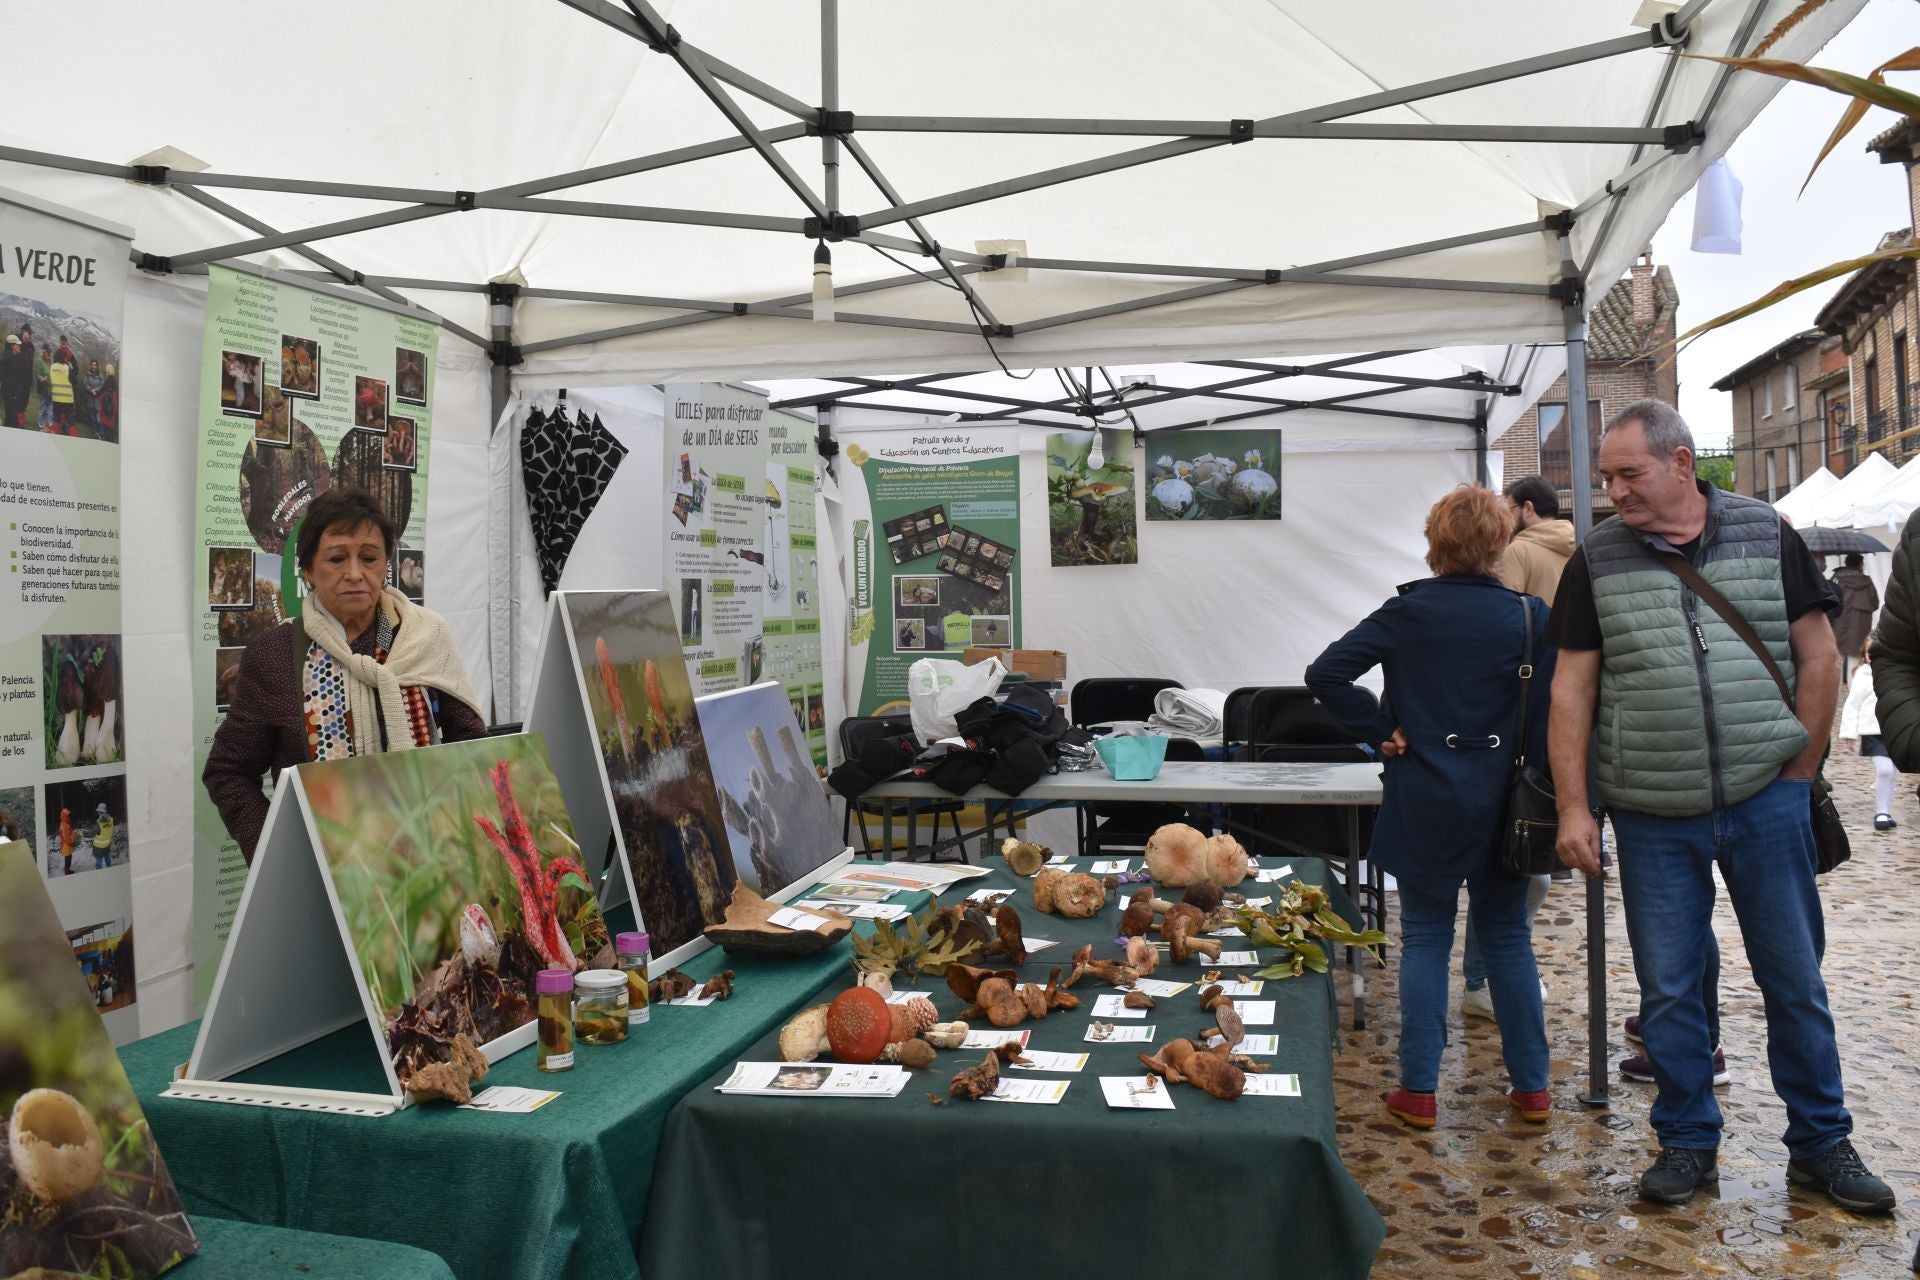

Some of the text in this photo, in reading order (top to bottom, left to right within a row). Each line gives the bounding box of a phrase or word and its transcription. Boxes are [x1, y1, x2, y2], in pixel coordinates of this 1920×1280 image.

[16, 246, 96, 286] VERDE
[676, 398, 763, 423] ÚTILES para disfrutar
[208, 430, 236, 439] Clitocybe
[683, 426, 758, 446] de un DÍA de SETAS
[943, 435, 963, 444] Verde
[880, 448, 918, 456] Educación
[932, 447, 960, 456] Centros
[963, 445, 1004, 454] Educativos
[879, 466, 908, 474] Diputación
[10, 480, 24, 492] que
[18, 494, 27, 504] de
[30, 498, 75, 508] ecosistemas
[77, 502, 110, 512] presentes
[22, 523, 54, 534] Conocen
[56, 526, 62, 535] la
[65, 526, 107, 538] importancia
[21, 537, 73, 549] biodiversidad.
[22, 551, 44, 561] Saben
[69, 553, 100, 564] disfrutar
[102, 555, 109, 564] de
[22, 565, 45, 575] Saben
[62, 566, 82, 576] hacer
[85, 569, 100, 578] para
[102, 570, 112, 579] que
[858, 540, 866, 607] VOLUNTARIADO
[22, 580, 69, 591] generaciones
[71, 580, 97, 590] futuras
[22, 593, 66, 603] la disfruten.
[2, 675, 35, 685] Palencia.
[10, 690, 35, 701] plantas
[4, 731, 32, 742] natural.
[2, 746, 24, 756] de los
